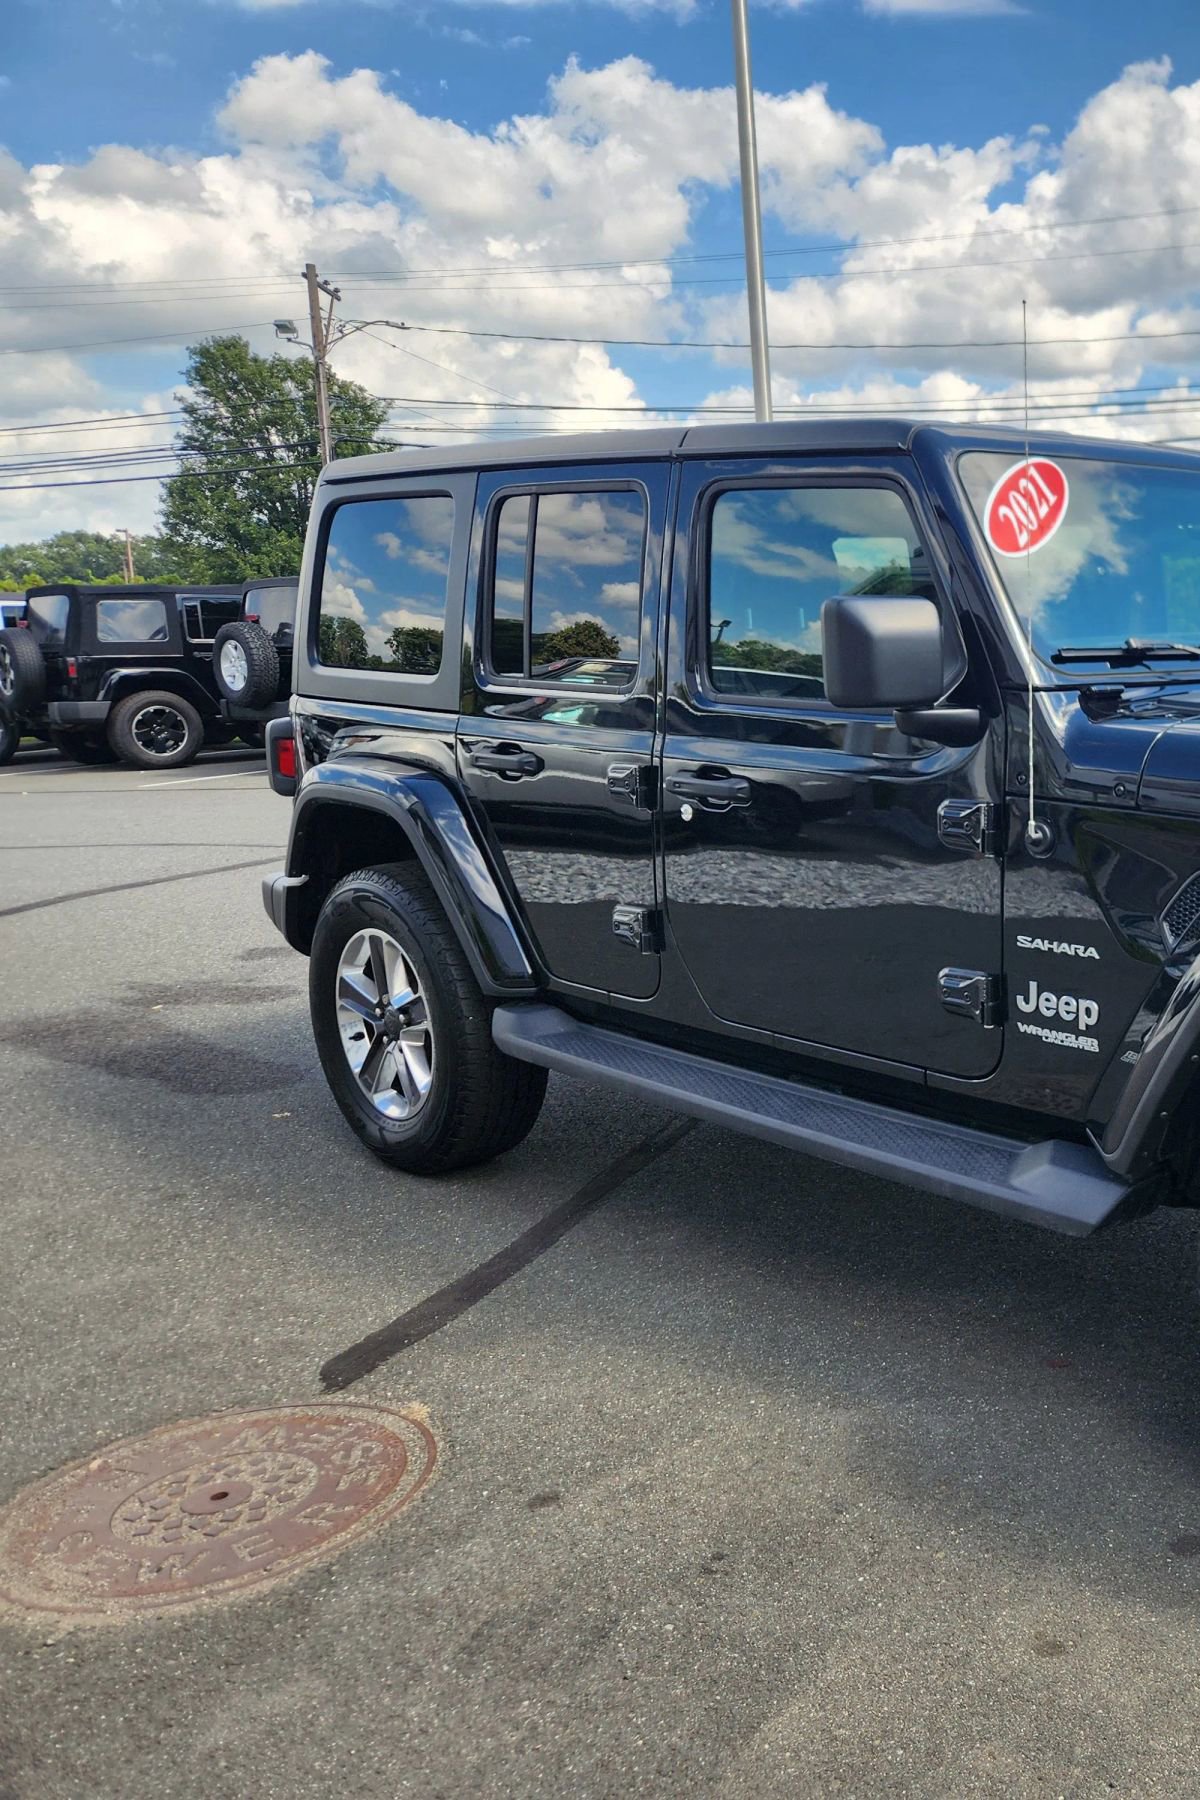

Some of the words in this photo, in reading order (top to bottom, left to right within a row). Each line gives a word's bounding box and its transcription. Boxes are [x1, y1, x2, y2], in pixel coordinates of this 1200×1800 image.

[998, 465, 1057, 548] 2021
[1016, 935, 1100, 960] SAHARA
[1016, 981, 1099, 1031] Jeep
[1016, 1021, 1099, 1048] WRANGLER
